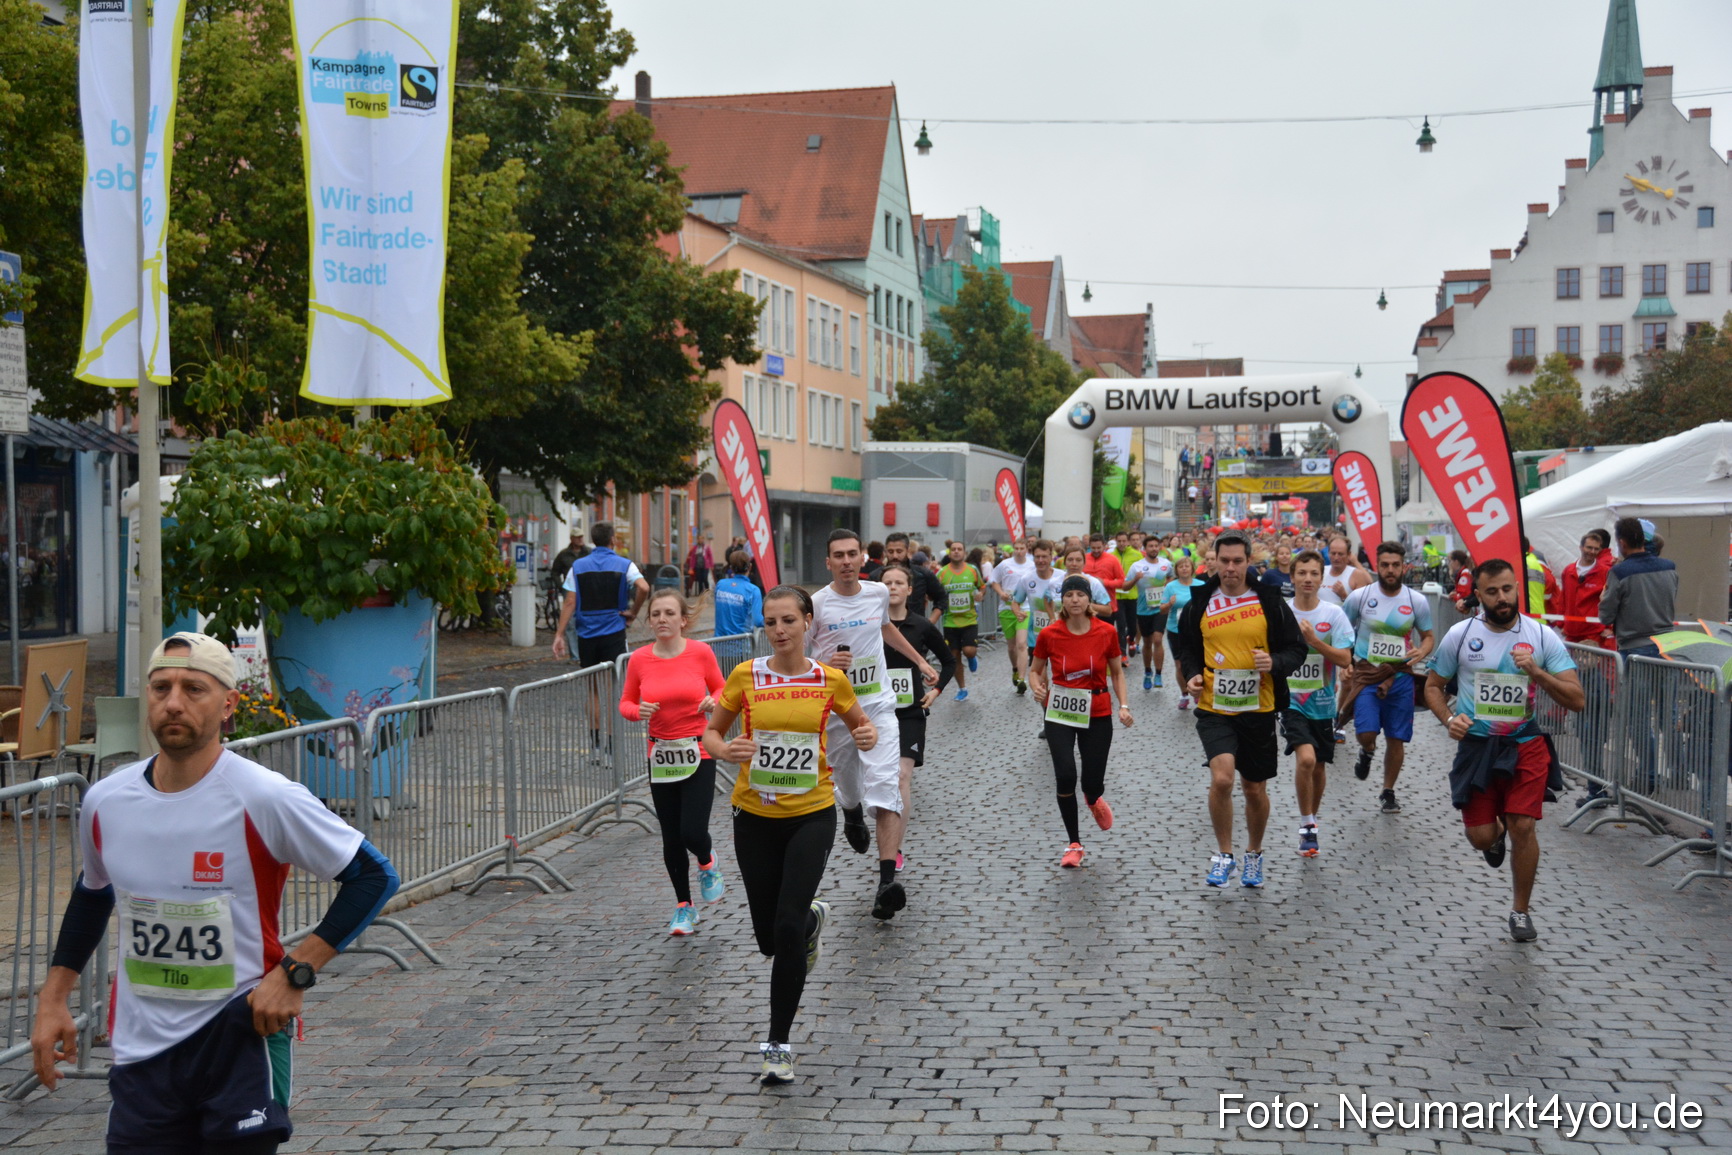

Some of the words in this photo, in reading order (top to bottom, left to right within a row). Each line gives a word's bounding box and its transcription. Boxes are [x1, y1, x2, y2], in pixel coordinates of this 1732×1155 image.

[311, 58, 385, 76] Kampagne
[312, 72, 393, 92] Fairtrade
[347, 97, 387, 112] Towns
[401, 99, 435, 109] FAIRTRADE
[320, 186, 362, 212] Wir
[367, 190, 413, 215] sind
[321, 223, 433, 250] Fairtrade-
[323, 259, 387, 285] Stadt!
[1105, 388, 1180, 411] BMW
[1188, 385, 1322, 412] Laufsport
[1262, 481, 1288, 489] ZIEL
[517, 547, 526, 560] P
[950, 596, 970, 606] 5264
[1035, 616, 1051, 628] 507
[1207, 614, 1237, 630] MAX
[1371, 641, 1403, 657] 5202
[849, 665, 876, 685] 107
[1293, 663, 1320, 679] 306
[891, 678, 909, 693] 69
[1217, 678, 1257, 695] 5242
[754, 691, 786, 703] MAX
[790, 688, 827, 700] BÖGL
[1480, 684, 1524, 704] 5262
[1052, 694, 1087, 713] 5088
[1487, 706, 1513, 715] Khaled
[655, 748, 697, 765] 5018
[758, 744, 814, 771] 5222
[769, 774, 797, 785] Judith
[194, 871, 222, 880] DKMS
[162, 901, 220, 917] BOCK
[131, 919, 223, 961] 5243
[161, 968, 189, 986] Tilo
